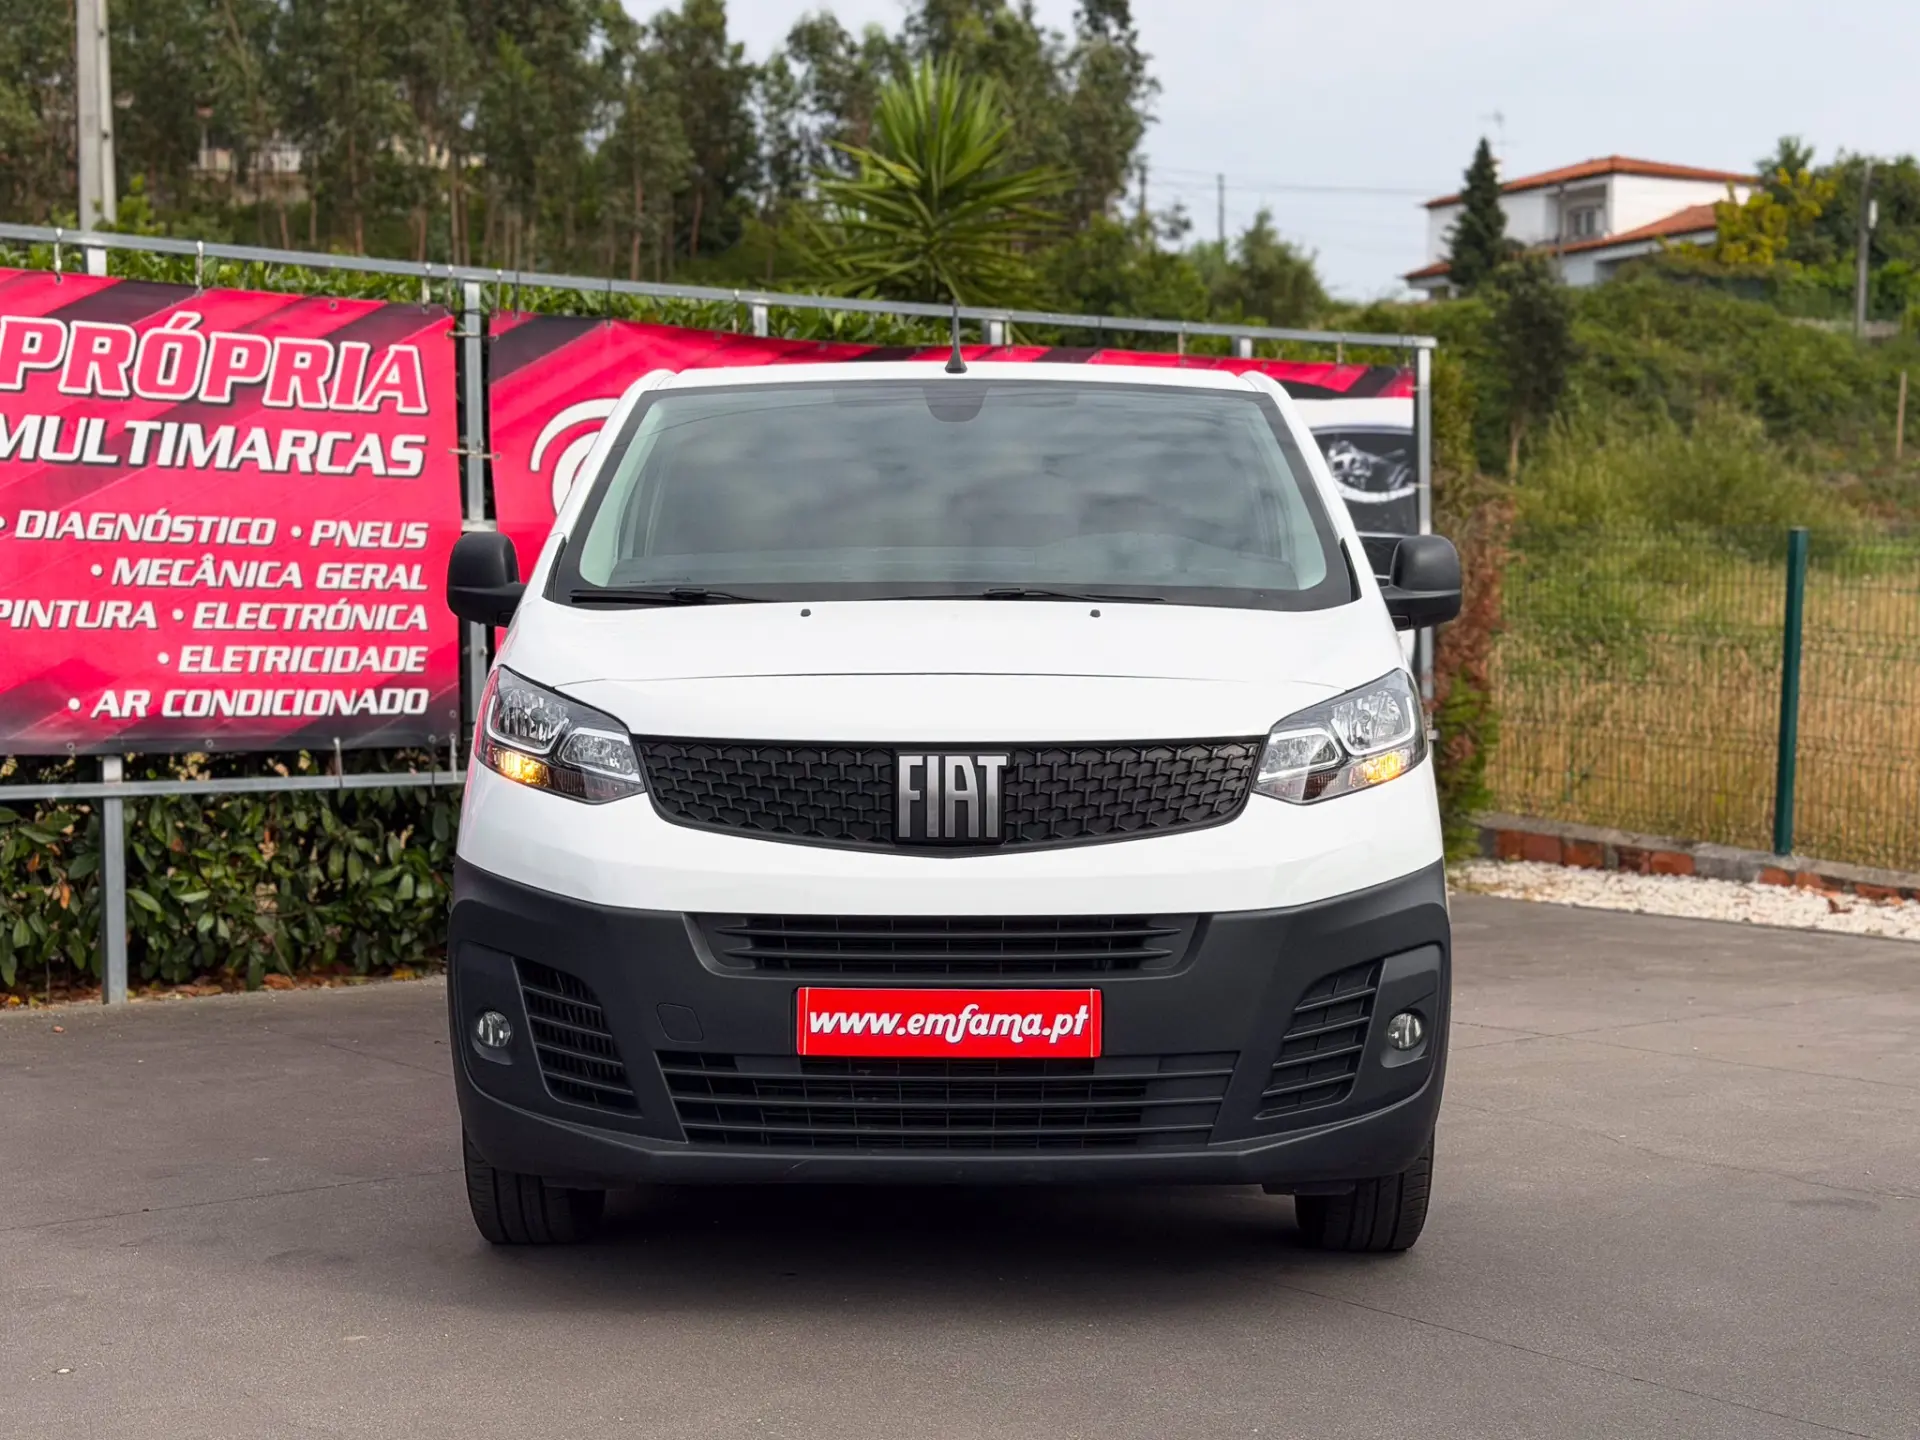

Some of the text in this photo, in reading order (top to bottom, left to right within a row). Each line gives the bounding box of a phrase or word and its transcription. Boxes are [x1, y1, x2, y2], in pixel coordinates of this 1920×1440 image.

[0, 312, 428, 414] PRÓPRIA
[0, 414, 427, 477] MULTIMARCAS
[15, 508, 428, 548] DIAGNÓSTICO PNEUS
[111, 554, 427, 590] MECÂNICA GERAL
[192, 598, 428, 631] ELECTRÓNICA
[178, 646, 428, 673] ELETRICIDADE
[90, 689, 428, 718] AR CONDICIONADO
[899, 755, 1007, 838] FIAT
[809, 1003, 1089, 1044] www.emfama.pt
